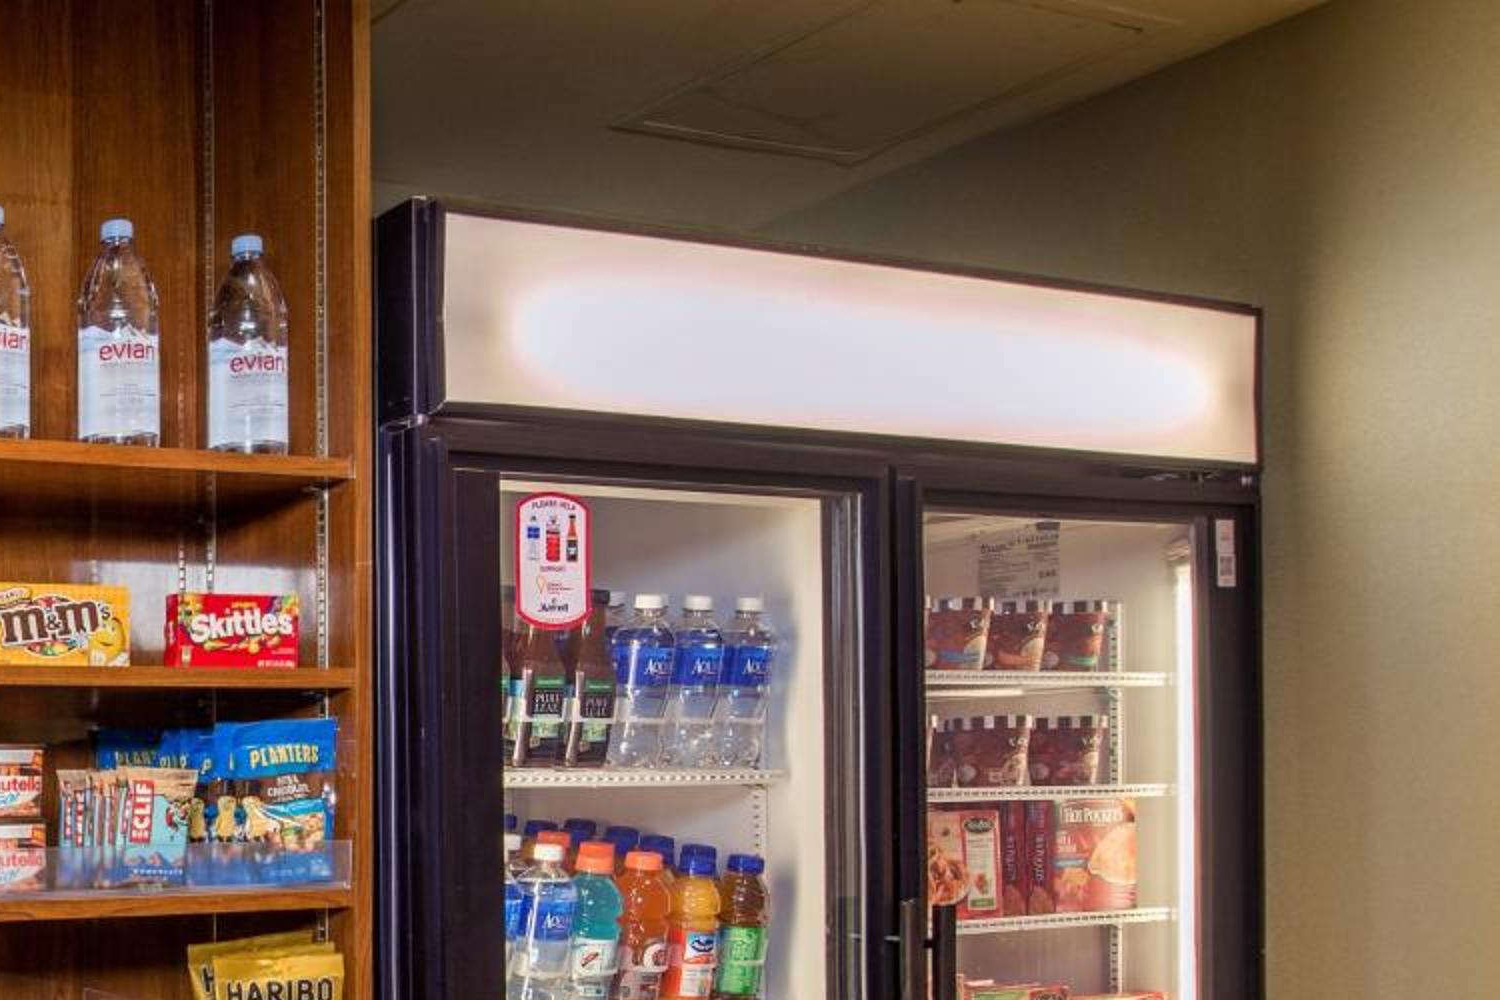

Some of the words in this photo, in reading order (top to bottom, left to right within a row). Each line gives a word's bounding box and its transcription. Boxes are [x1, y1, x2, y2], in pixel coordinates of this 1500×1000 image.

[100, 340, 155, 362] evian
[229, 352, 285, 373] evian
[189, 606, 293, 644] Skittles
[249, 744, 320, 769] PLANTERS
